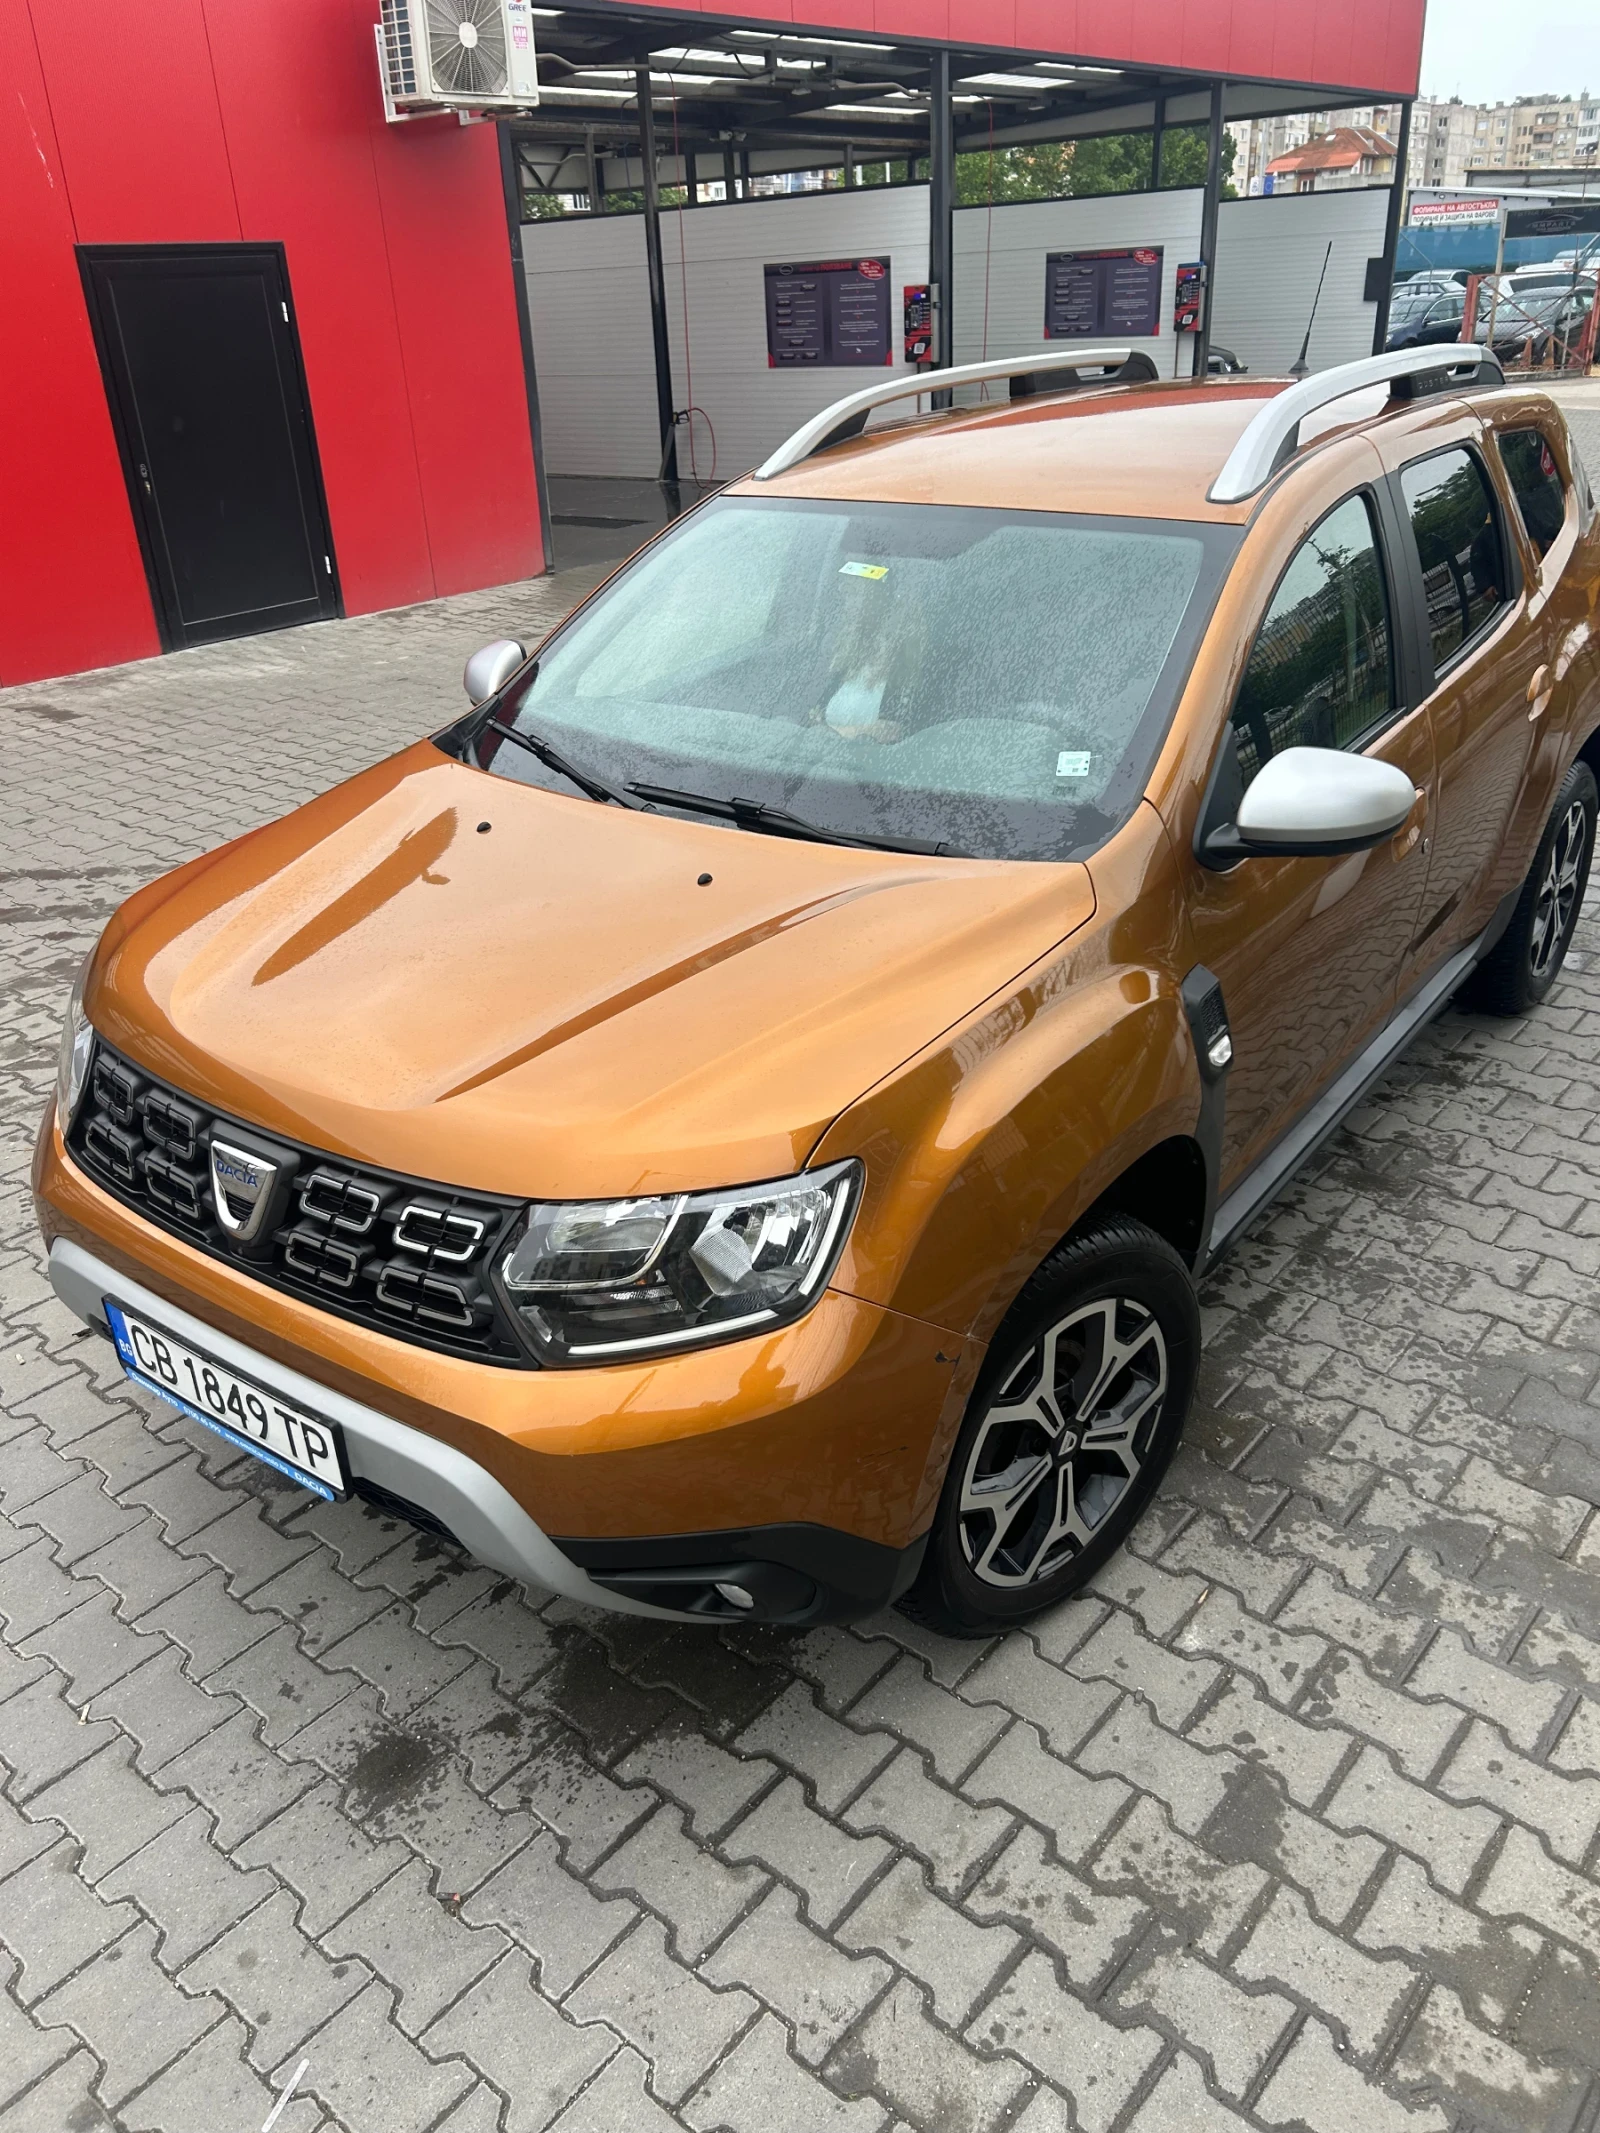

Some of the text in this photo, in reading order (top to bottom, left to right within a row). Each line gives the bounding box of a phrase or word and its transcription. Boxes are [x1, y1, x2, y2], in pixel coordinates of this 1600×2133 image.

[508, 3, 526, 11] GREE
[1413, 201, 1497, 214] ФОЛИРАНЕ НА АВТОСТЪКЛА
[1413, 215, 1439, 223] ПОЛИРАНЕ
[1445, 213, 1466, 221] ЗАЩИТА
[1474, 210, 1496, 218] ФАРОВЕ
[1418, 376, 1449, 389] DUSTER
[216, 1159, 258, 1187] DACIA
[118, 1338, 133, 1357] BG
[131, 1325, 329, 1469] CB 1849 TP
[294, 1471, 328, 1498] DACIA
